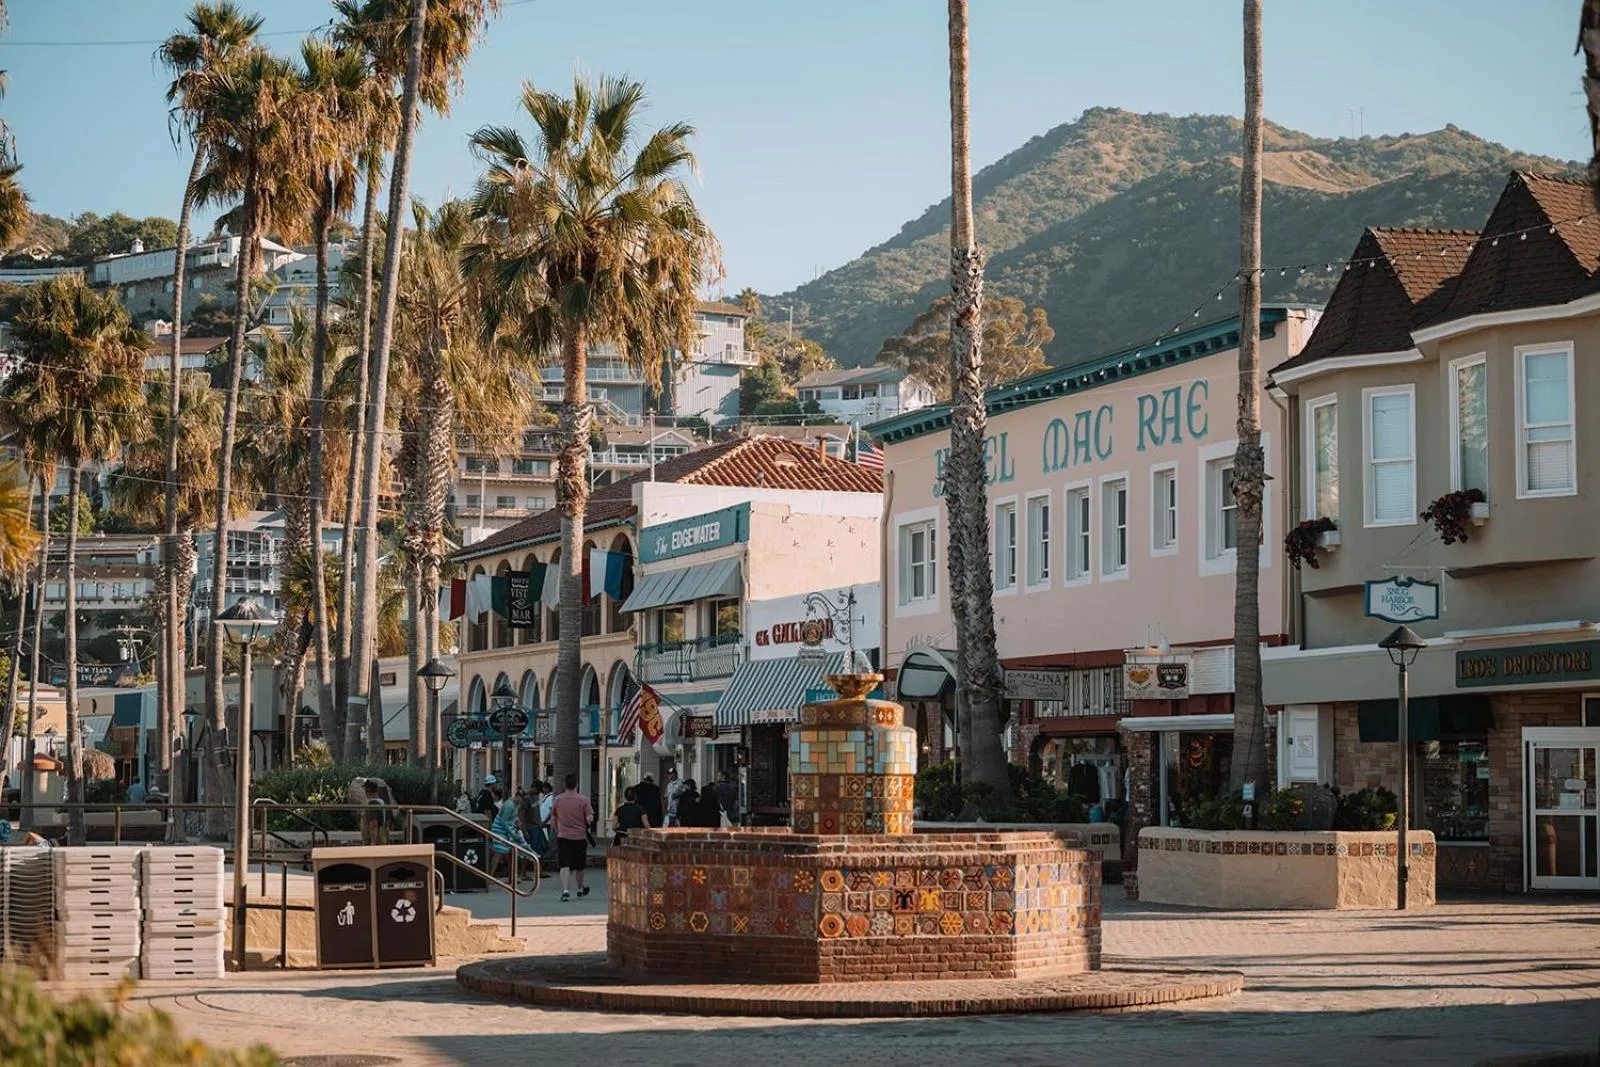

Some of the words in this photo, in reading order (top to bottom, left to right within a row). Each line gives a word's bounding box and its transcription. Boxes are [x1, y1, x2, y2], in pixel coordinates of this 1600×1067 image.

[1042, 403, 1114, 474] MAC
[1136, 379, 1209, 452] RAE
[671, 521, 721, 550] EDGEWATER
[510, 588, 529, 598] VIST
[511, 609, 531, 620] MAR
[1502, 649, 1592, 676] DRUGSTORE
